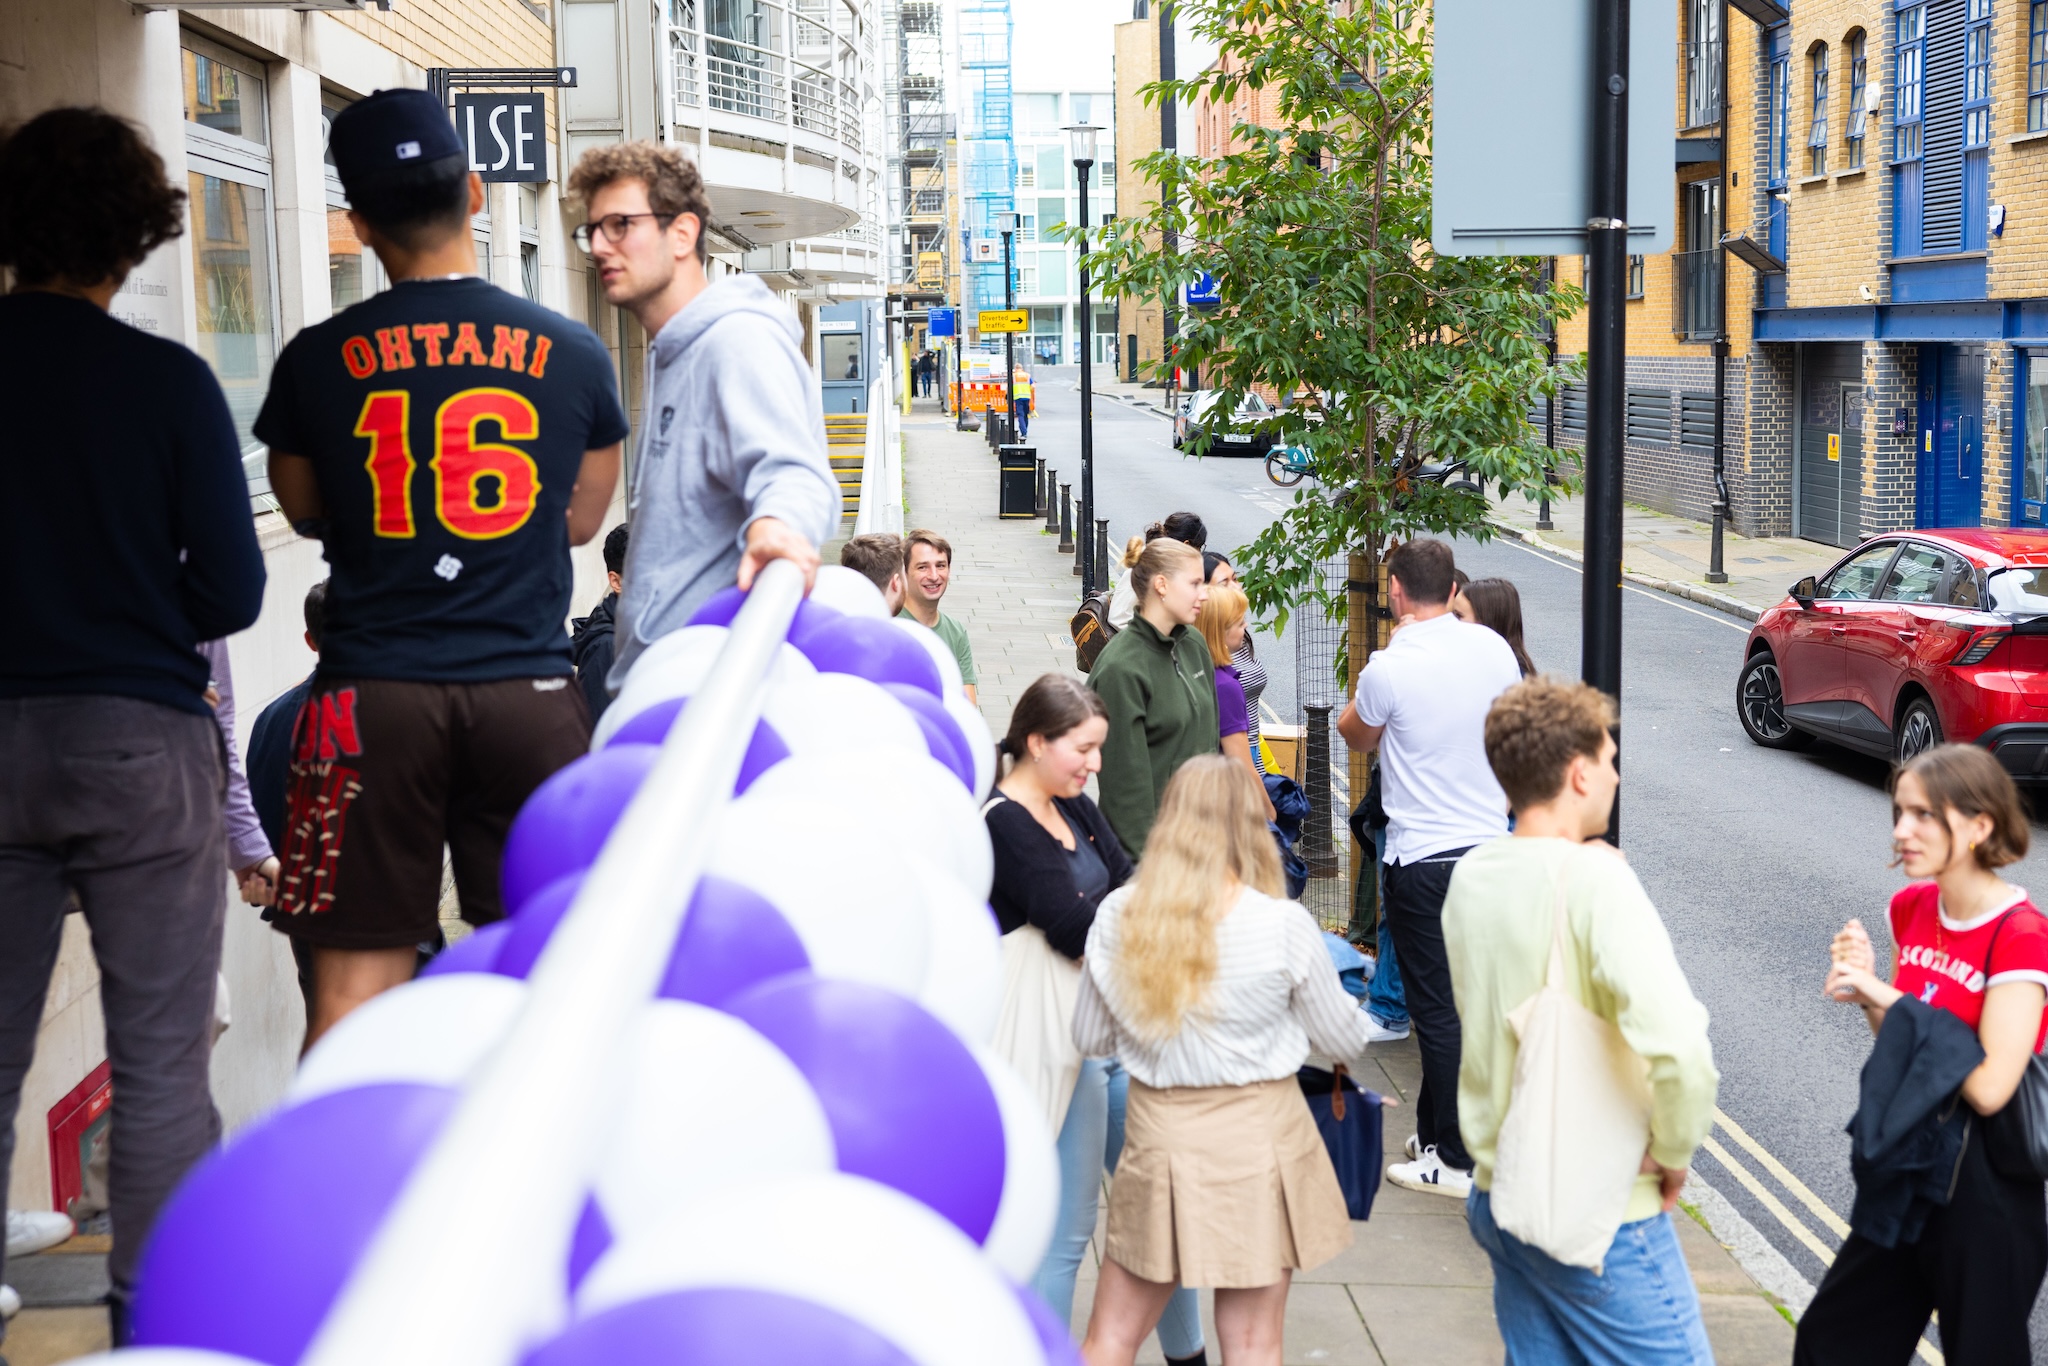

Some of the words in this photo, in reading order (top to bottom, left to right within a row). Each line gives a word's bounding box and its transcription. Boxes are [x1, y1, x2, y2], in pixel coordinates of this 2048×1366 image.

[466, 104, 535, 171] LSE
[140, 278, 168, 297] Economics
[341, 322, 552, 379] OHTANI
[353, 386, 542, 540] 16
[1899, 944, 1986, 993] SCOTLAND
